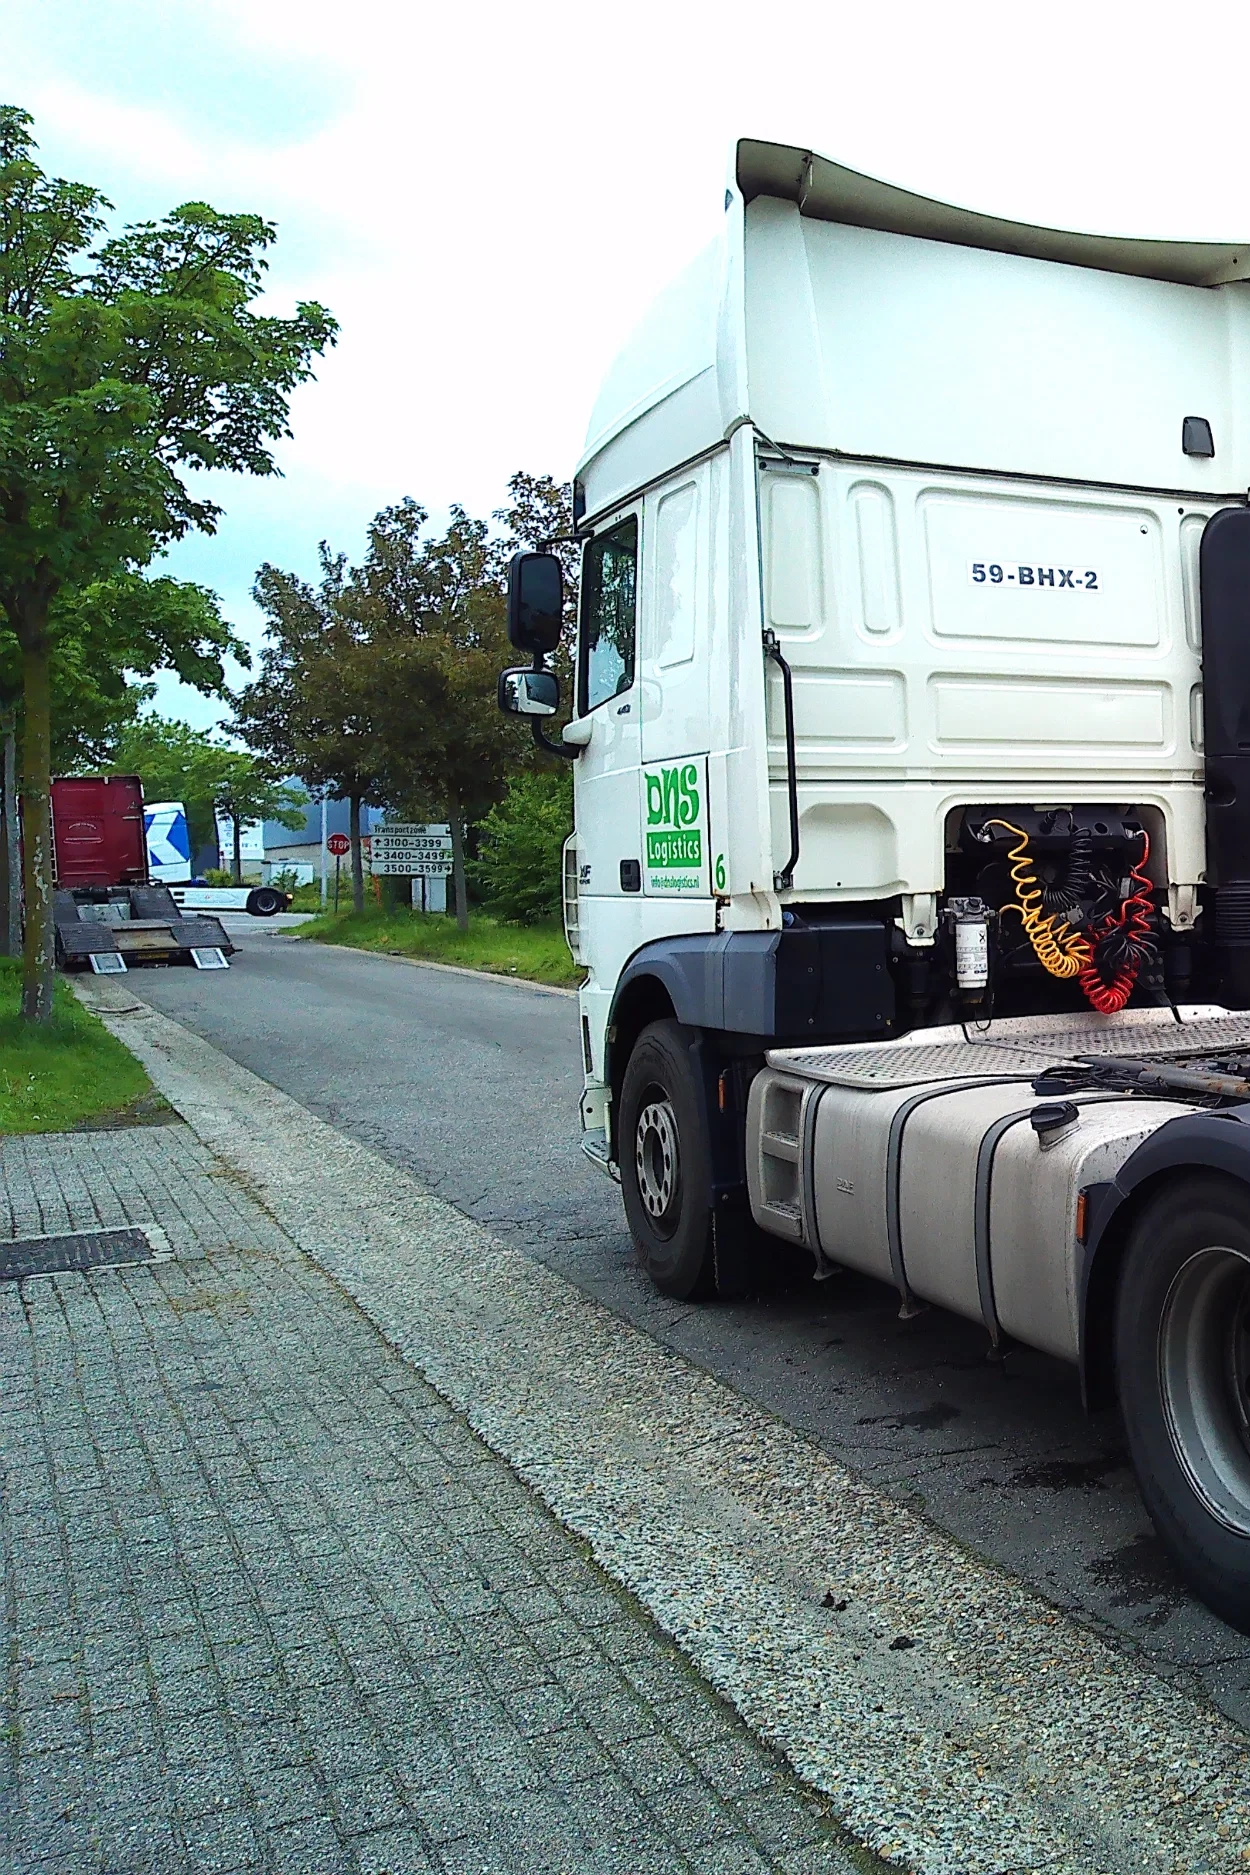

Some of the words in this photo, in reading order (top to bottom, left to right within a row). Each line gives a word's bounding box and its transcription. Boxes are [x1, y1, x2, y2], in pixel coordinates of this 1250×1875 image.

[972, 563, 1099, 590] 59-BHX-2
[327, 840, 350, 849] STOP
[384, 838, 442, 848] 3100-3399
[384, 851, 445, 860] 3400-3499
[648, 834, 700, 867] Logistics
[384, 864, 443, 873] 3500-3599
[715, 854, 726, 889] 6
